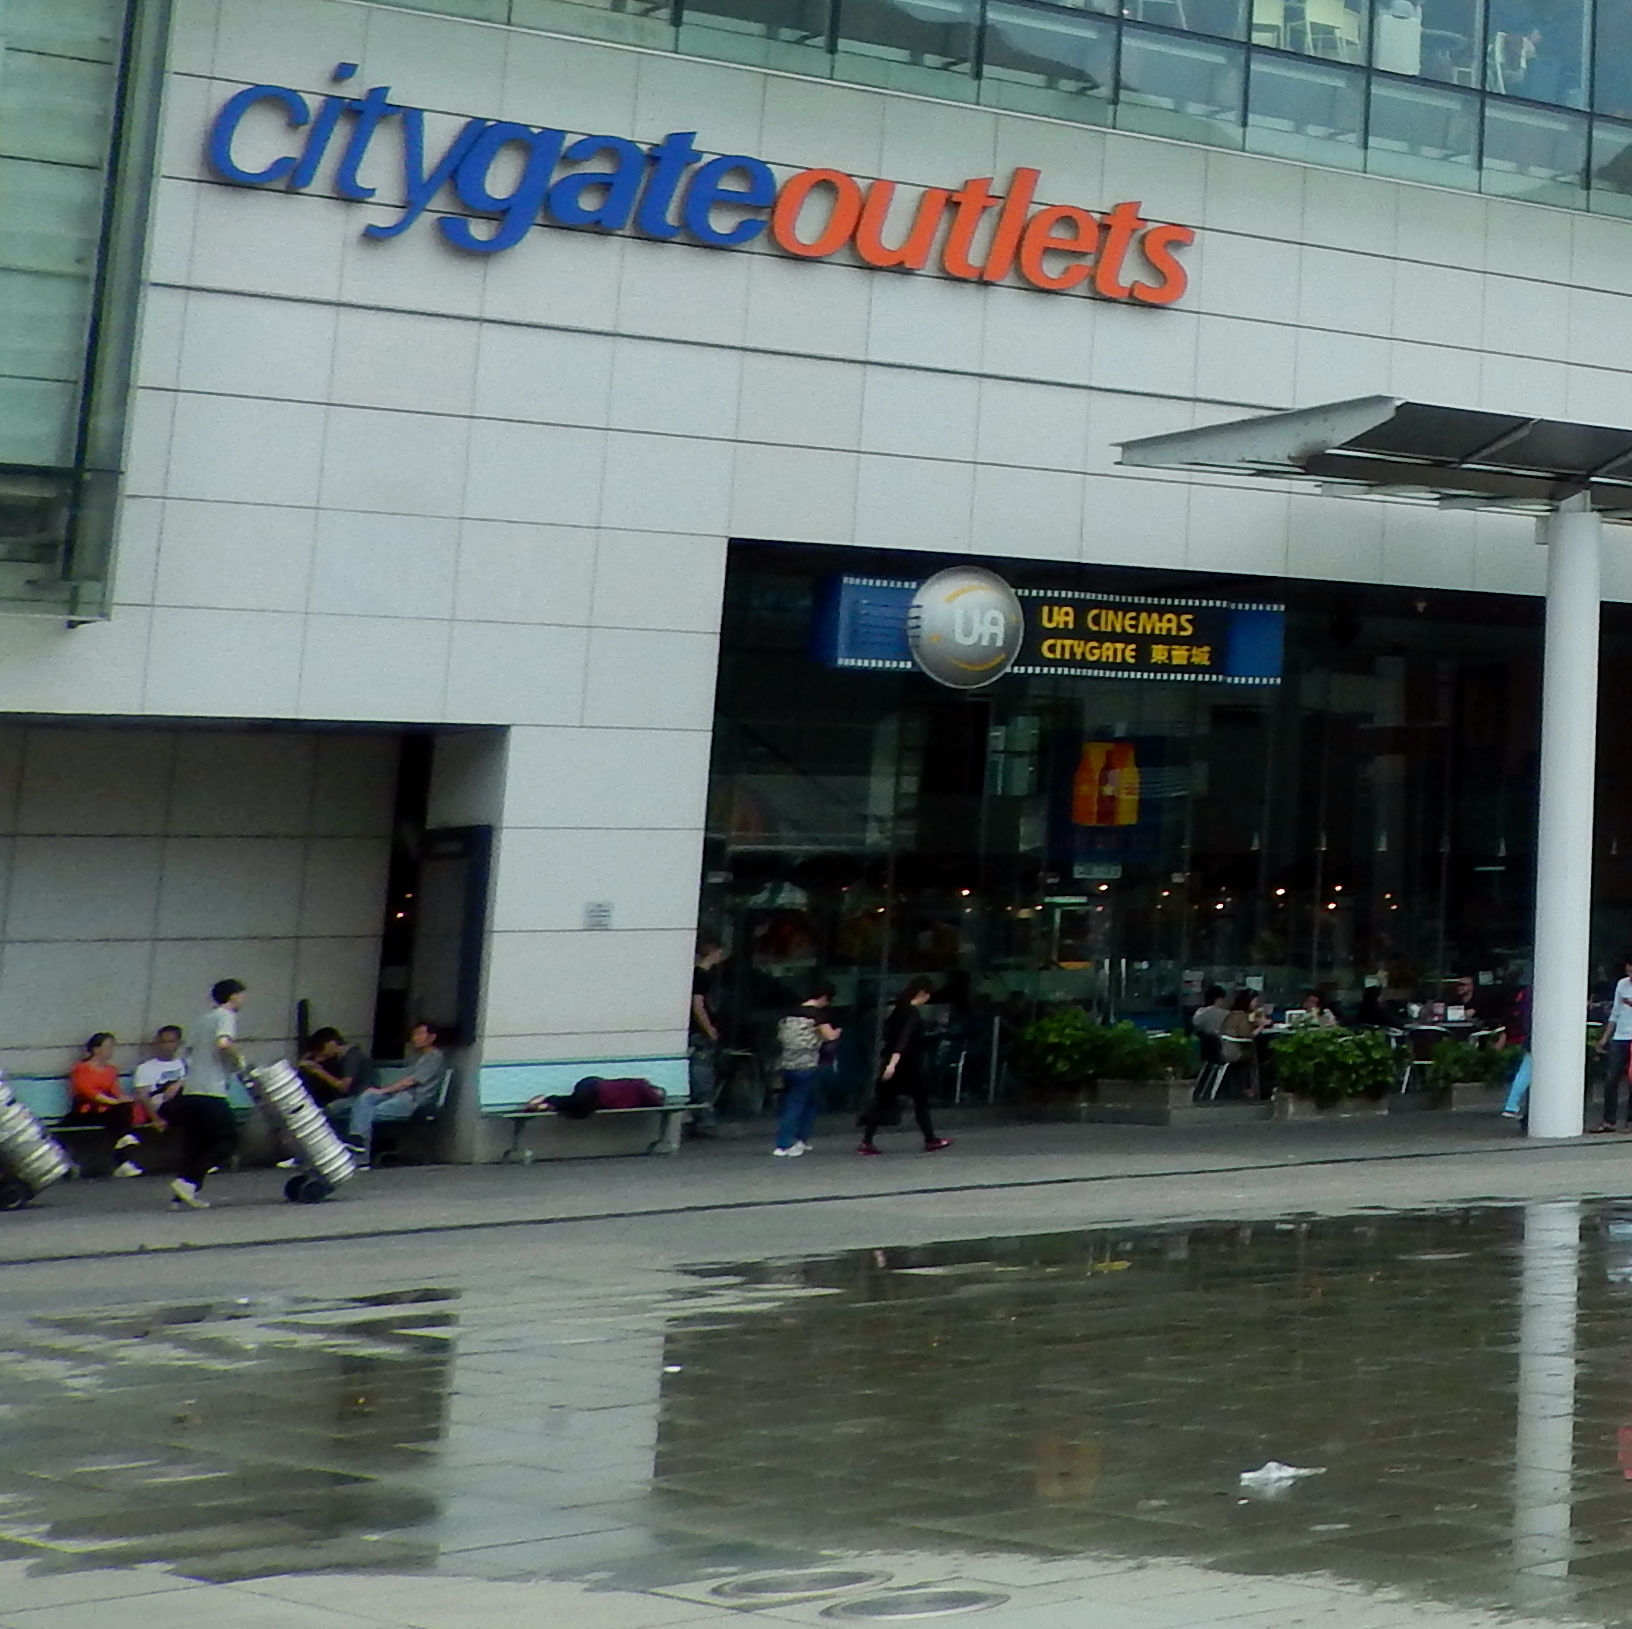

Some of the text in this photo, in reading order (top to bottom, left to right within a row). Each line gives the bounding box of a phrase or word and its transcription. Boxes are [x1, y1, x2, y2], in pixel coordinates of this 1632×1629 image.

[954, 608, 1005, 647] UA
[1041, 605, 1194, 637] UA CINEMAS
[1041, 638, 1212, 666] CITYGATE 東薈城
